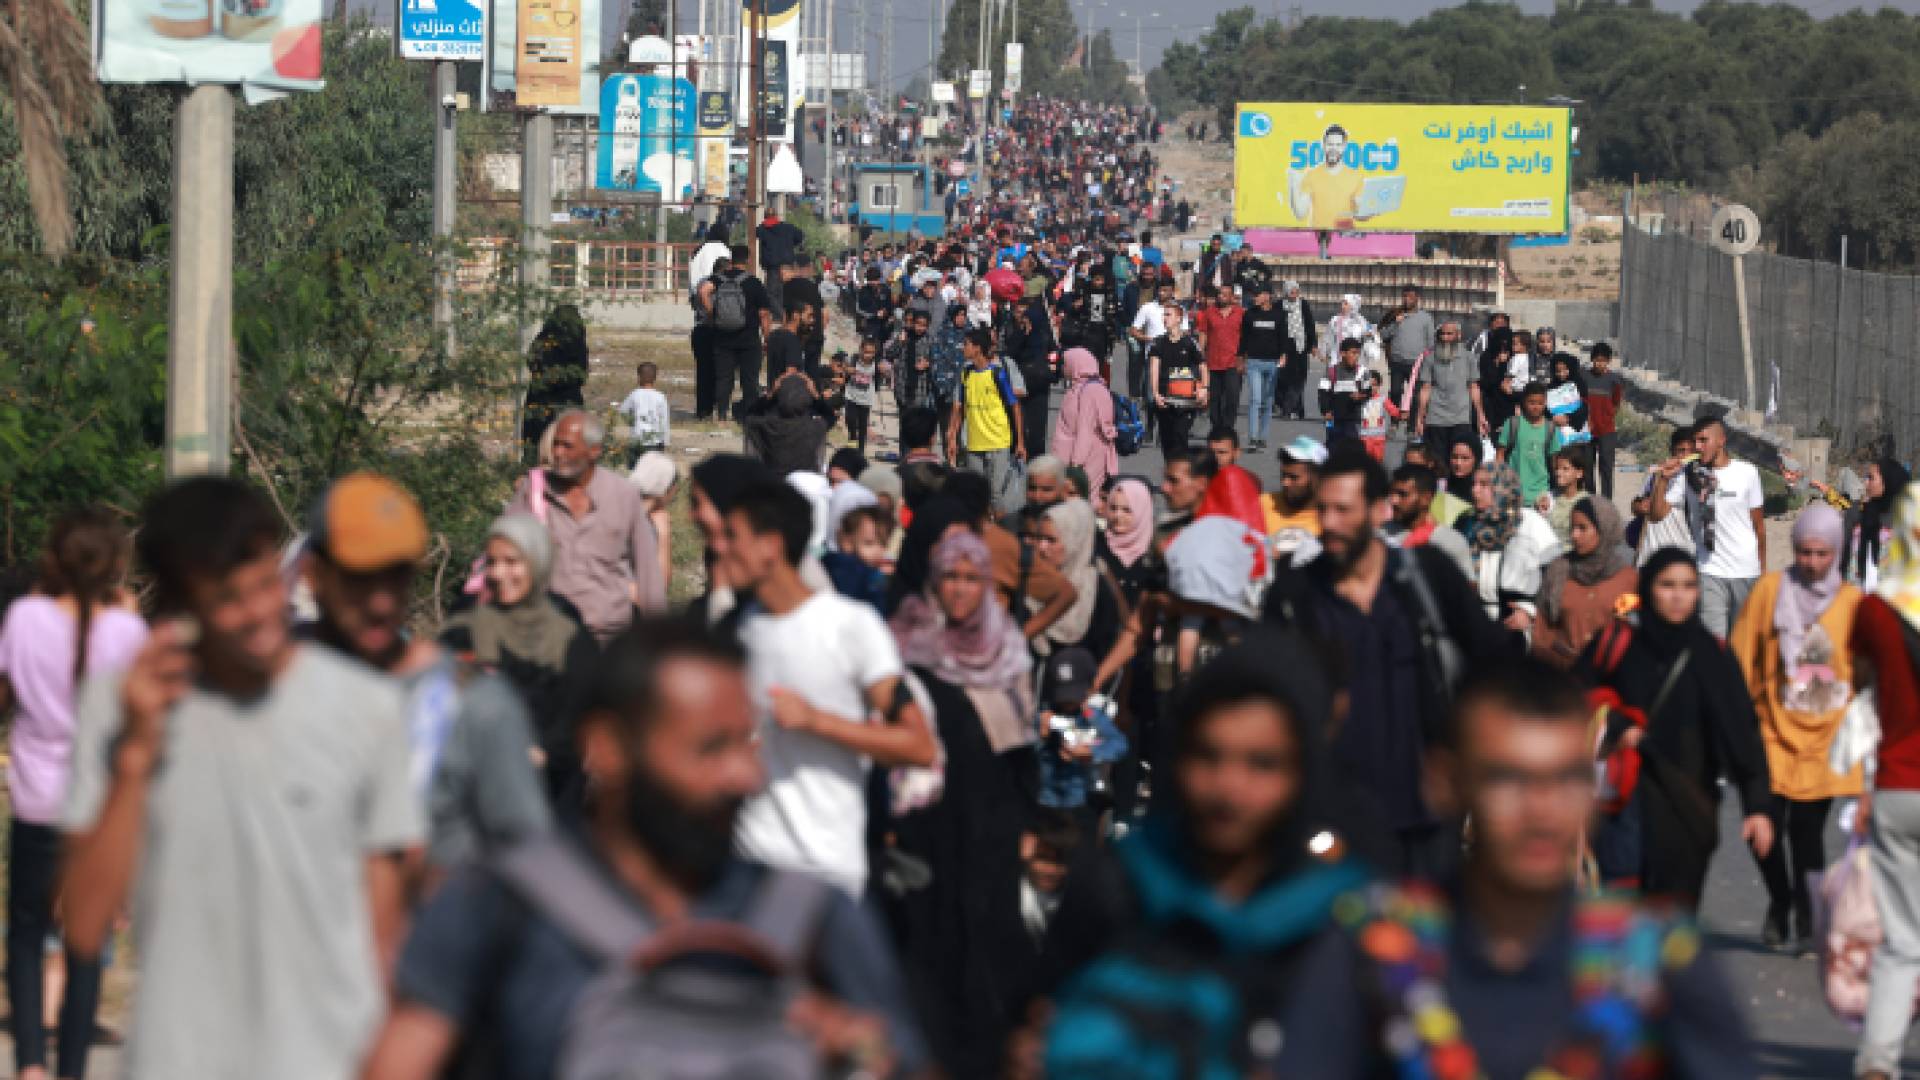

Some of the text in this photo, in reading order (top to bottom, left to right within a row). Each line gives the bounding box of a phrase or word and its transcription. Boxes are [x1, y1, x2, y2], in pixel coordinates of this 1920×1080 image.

[411, 19, 455, 38] منزلي
[1422, 114, 1553, 144] اشبك أوفر نت
[1452, 148, 1553, 174] واربح كاش
[1722, 218, 1745, 244] 40
